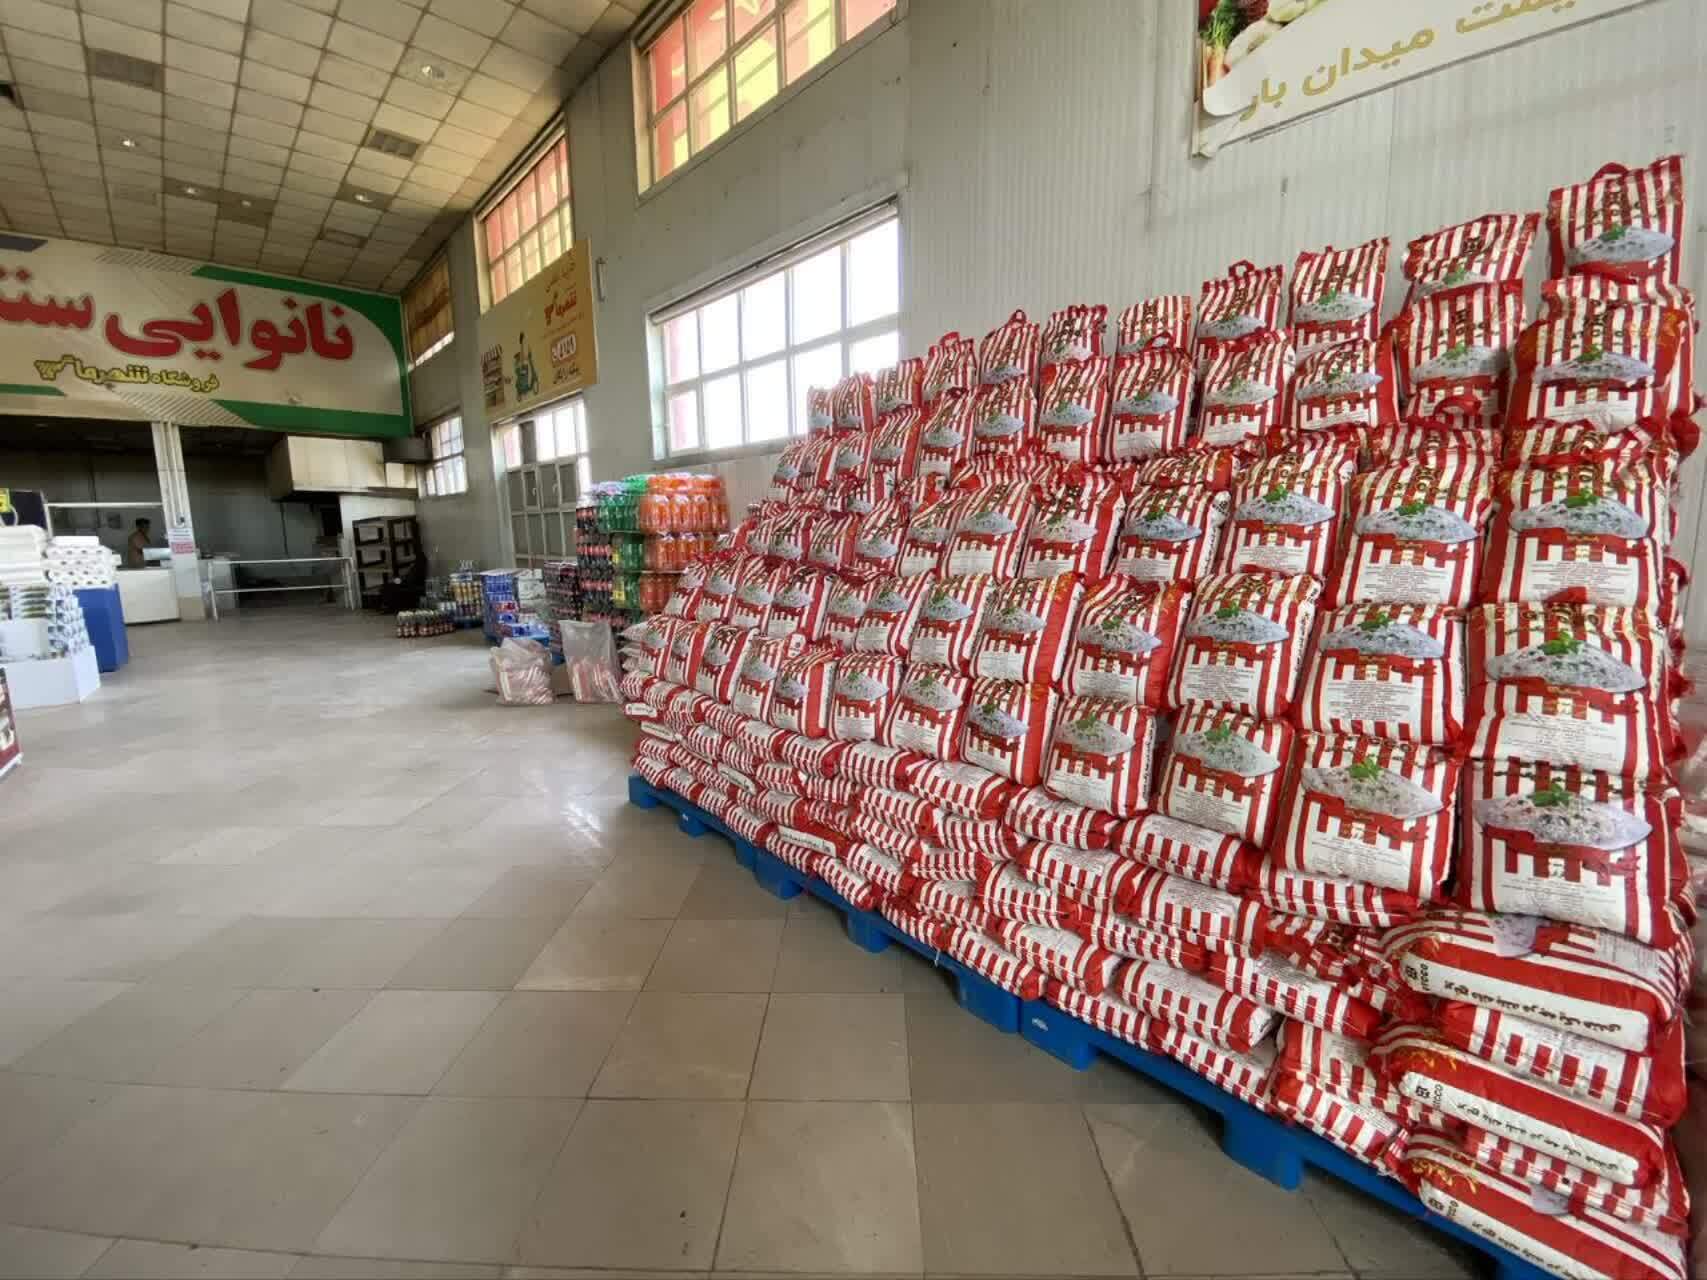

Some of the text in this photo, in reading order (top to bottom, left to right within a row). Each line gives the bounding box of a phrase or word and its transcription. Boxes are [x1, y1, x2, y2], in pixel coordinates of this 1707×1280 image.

[1301, 26, 1437, 97] میدان
[1239, 77, 1289, 122] بار
[105, 288, 354, 371] نانوایی
[150, 370, 220, 393] فروشگاه
[1443, 979, 1470, 996] برنج
[1471, 991, 1495, 1003] دانه
[1496, 997, 1520, 1011] بلند
